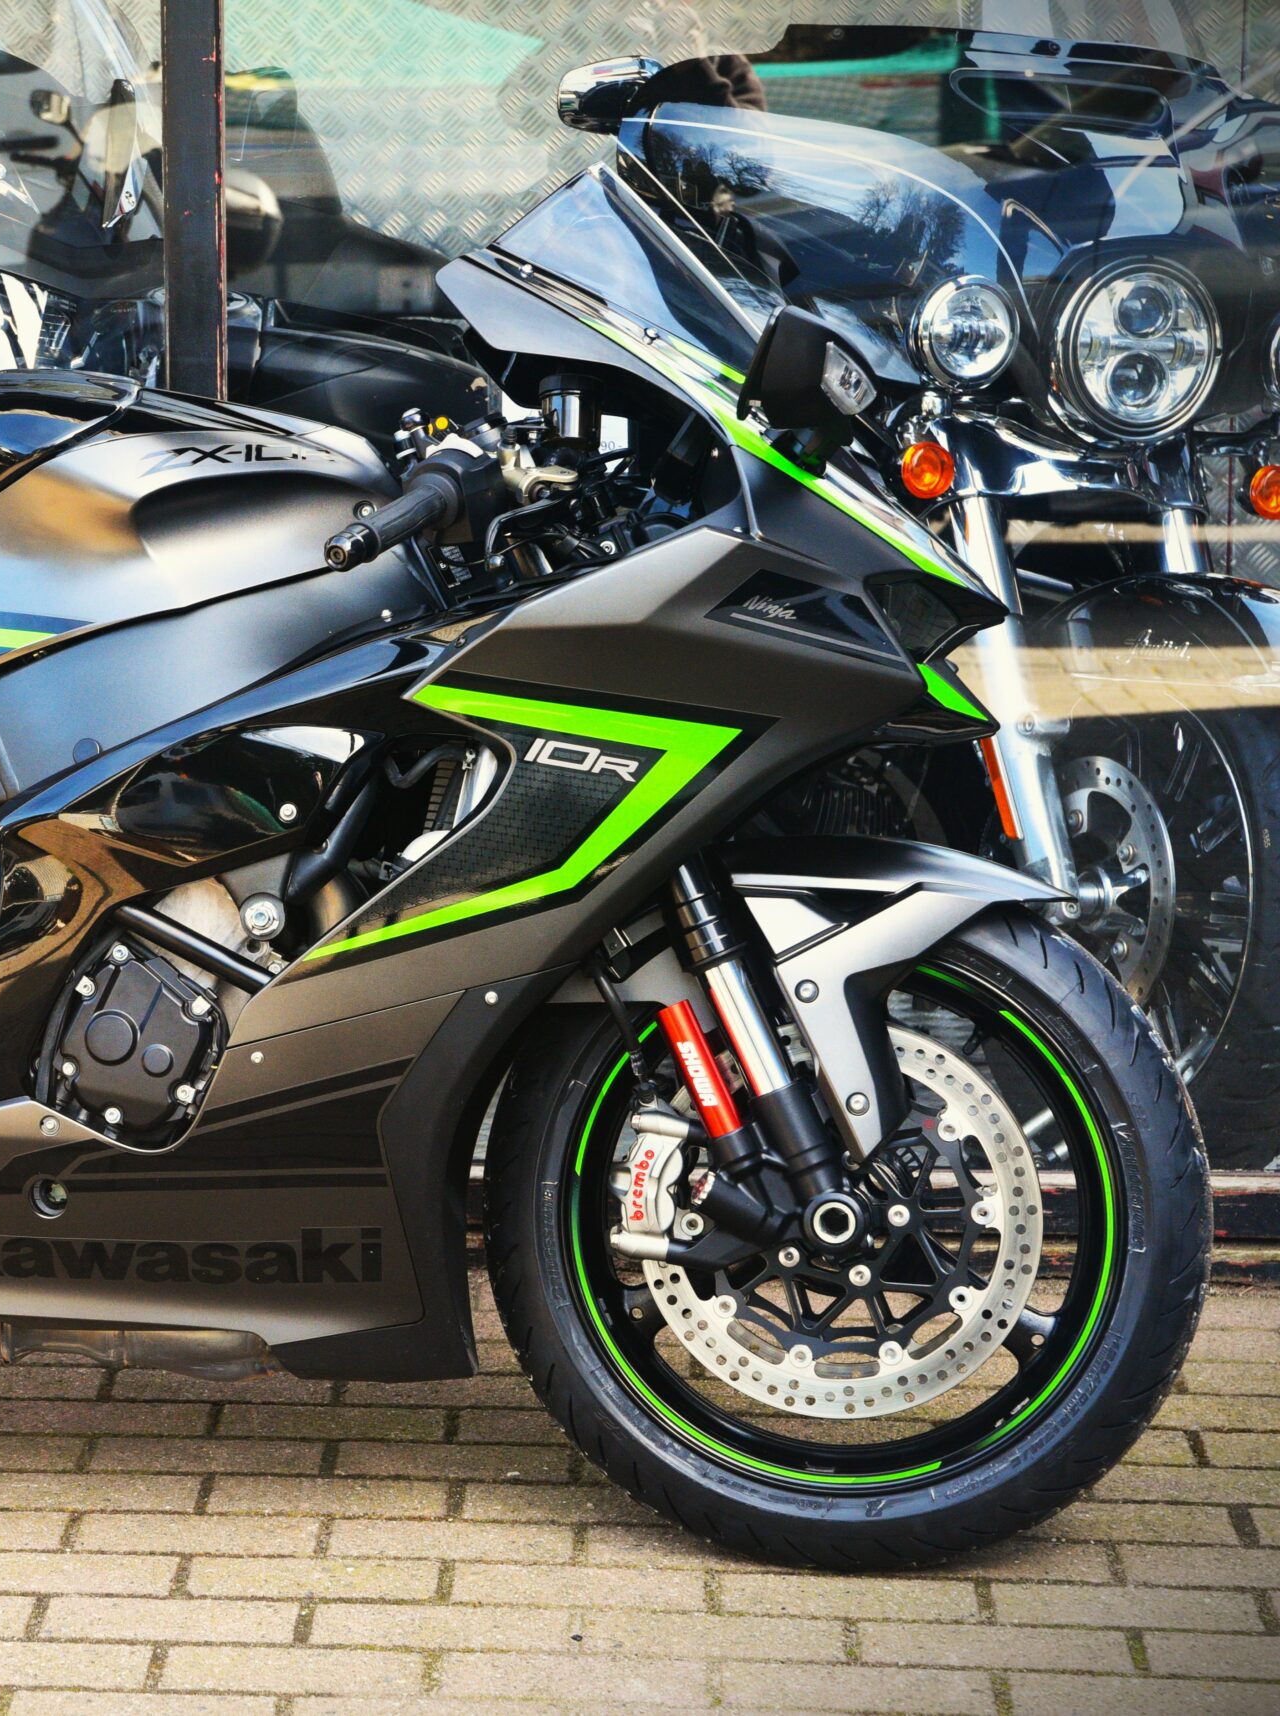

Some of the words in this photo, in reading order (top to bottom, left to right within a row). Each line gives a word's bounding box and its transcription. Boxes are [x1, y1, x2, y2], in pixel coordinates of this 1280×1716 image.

[742, 595, 797, 620] Ninja
[523, 738, 638, 783] 10R
[676, 1040, 719, 1107] SHOWA
[629, 1149, 655, 1222] brembo
